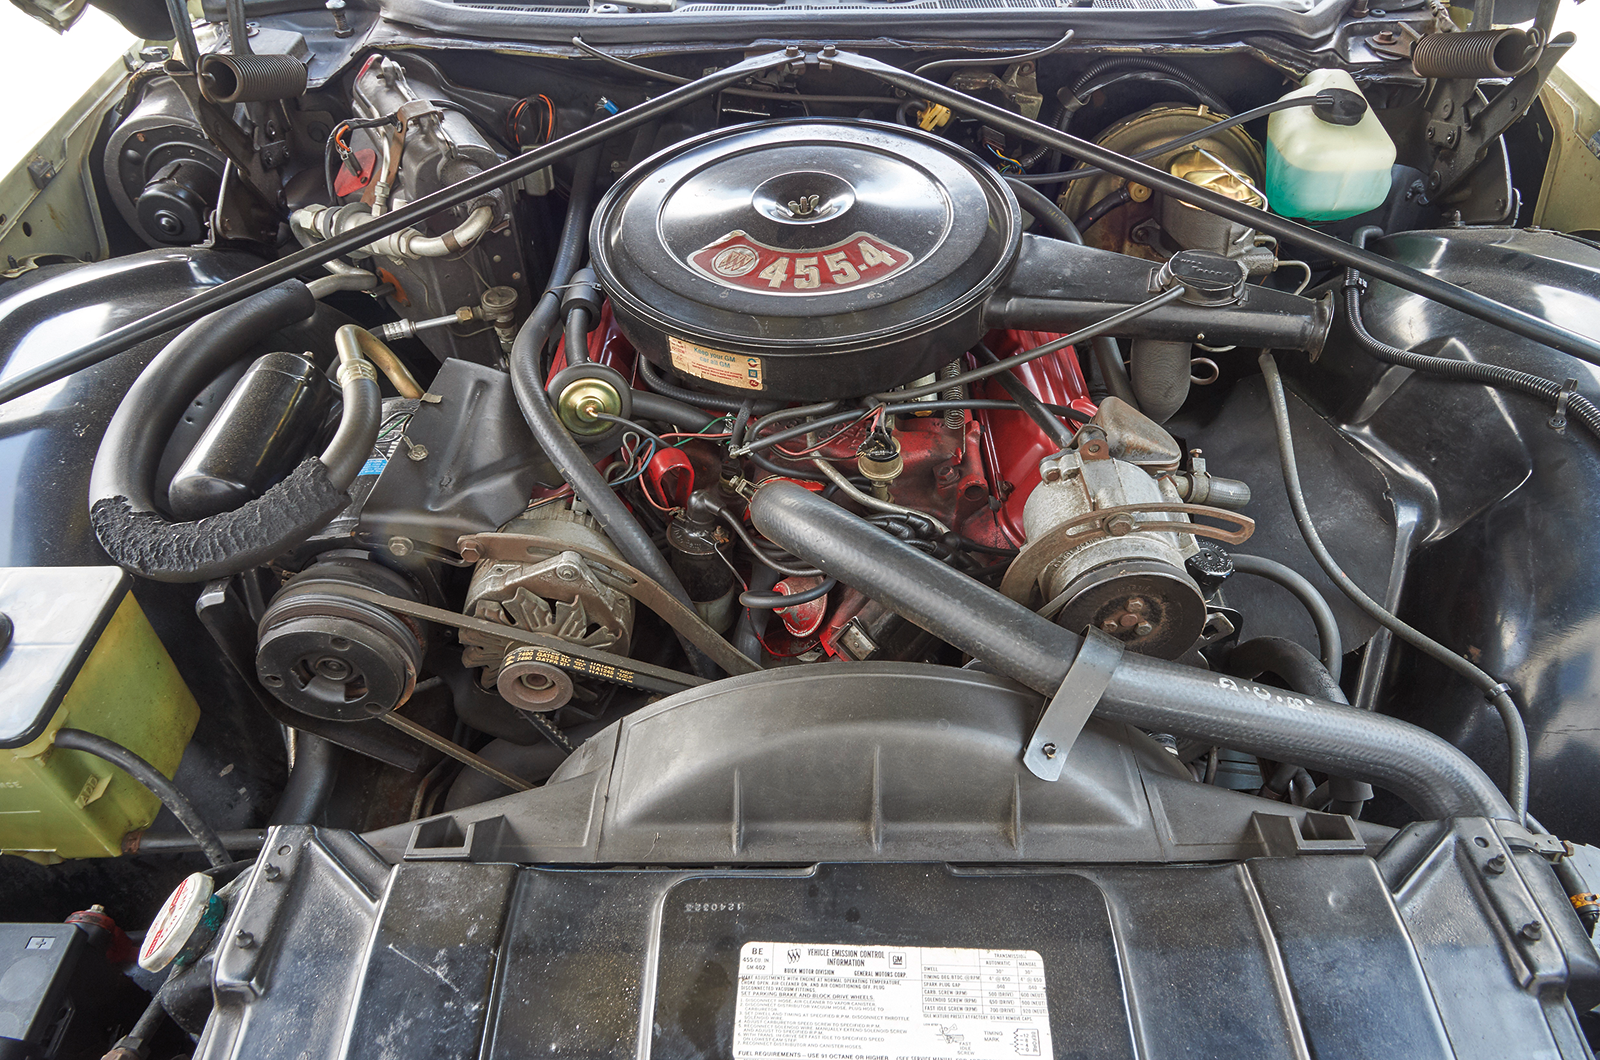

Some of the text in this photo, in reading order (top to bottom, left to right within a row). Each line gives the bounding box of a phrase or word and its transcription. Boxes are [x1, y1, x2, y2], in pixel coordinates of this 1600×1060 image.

[808, 948, 885, 959] VEHICLE EMISSION CONTROL
[827, 958, 865, 967] INFORMATION
